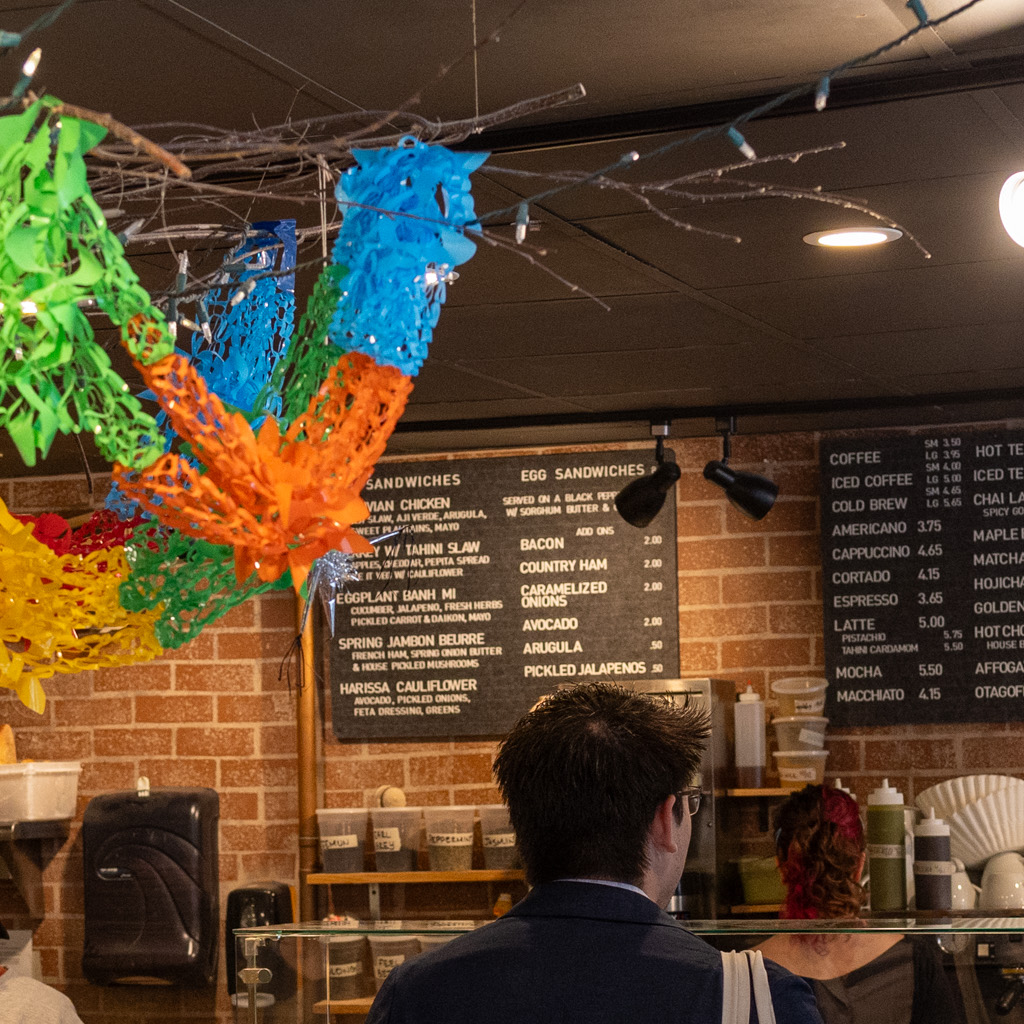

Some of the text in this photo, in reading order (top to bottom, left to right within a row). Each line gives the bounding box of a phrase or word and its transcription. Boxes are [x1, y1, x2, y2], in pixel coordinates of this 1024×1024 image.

[925, 439, 938, 448] SM
[830, 451, 881, 465] COFFEE
[926, 451, 938, 460] LG
[976, 444, 1002, 458] HOT
[521, 463, 645, 482] EGG SANDWICHES
[926, 462, 961, 471] SM 4.00
[365, 474, 461, 490] SANDWICHES
[831, 473, 913, 489] ICED COFFEE
[927, 474, 961, 484] LG 5.00
[973, 469, 1004, 482] ICED
[926, 487, 940, 496] SM
[400, 497, 451, 511] CHICKEN
[502, 492, 594, 506] SERVED ON A BLACK
[832, 497, 908, 513] COLD BREW
[927, 499, 939, 508] LG
[973, 493, 1005, 506] CHAI
[396, 513, 411, 522] AJI
[411, 512, 442, 522] VERDE,
[443, 510, 487, 520] ARUGULA,
[520, 506, 561, 516] SORGHUM
[566, 504, 599, 514] BUTTER
[602, 503, 610, 512] &
[983, 508, 1010, 517] SPICY
[435, 523, 459, 531] MAYO
[576, 526, 615, 537] ADD ONS
[832, 520, 942, 537] AMERICANO 3.75
[973, 528, 1019, 542] MAPLE
[406, 541, 480, 556] TAHINI SLAW
[520, 536, 662, 551] BACON 2.00
[832, 544, 943, 561] CAPPUCCINO 4.65
[425, 557, 454, 567] PEPITA
[457, 555, 490, 565] SPREAD
[520, 558, 662, 574] COUNTRY HAM 2.00
[409, 568, 463, 578] CAULIFLOWER
[832, 568, 941, 584] CORTADO 4.15
[520, 581, 663, 597] CARAMELIZED 2.00
[336, 588, 456, 605] EGGPLANT BANH MI
[521, 595, 568, 608] ONIONS
[833, 592, 943, 608] ESPRESSO 3.65
[350, 605, 394, 615] CUCUMBER,
[444, 601, 473, 611] FRESH
[474, 600, 503, 610] HERBS
[351, 612, 491, 626] PICKLED CARROT & DAIKON, MAYO
[522, 617, 663, 631] AVOCADO 2.00
[834, 615, 945, 632] LATTE 5.00
[842, 630, 963, 642] PISTACHIO 5.75
[974, 626, 1001, 639] HOT
[339, 633, 485, 650] SPRING JAMBON BEURRE
[523, 640, 583, 655] ARUGULA
[842, 642, 963, 655] TAHINI CARDAMOM 5.50
[987, 640, 1017, 649] HOUSE
[352, 647, 502, 660] FRENCH HAM, SPRING ONION BUTTER
[352, 659, 479, 672] & HOUSE PICKLED MUSHROOMS
[524, 664, 576, 678] PICKLED
[577, 662, 647, 676] JALAPENOS
[836, 664, 943, 679] MOCHA 5.50
[340, 679, 477, 695] HARISSA CAULIFLOWER
[354, 694, 471, 705] AVOCADO, PICKLED ONIONS,
[837, 688, 941, 702] MACCHIATO 4.15
[354, 705, 460, 717] FETA DRESSING, GREENS
